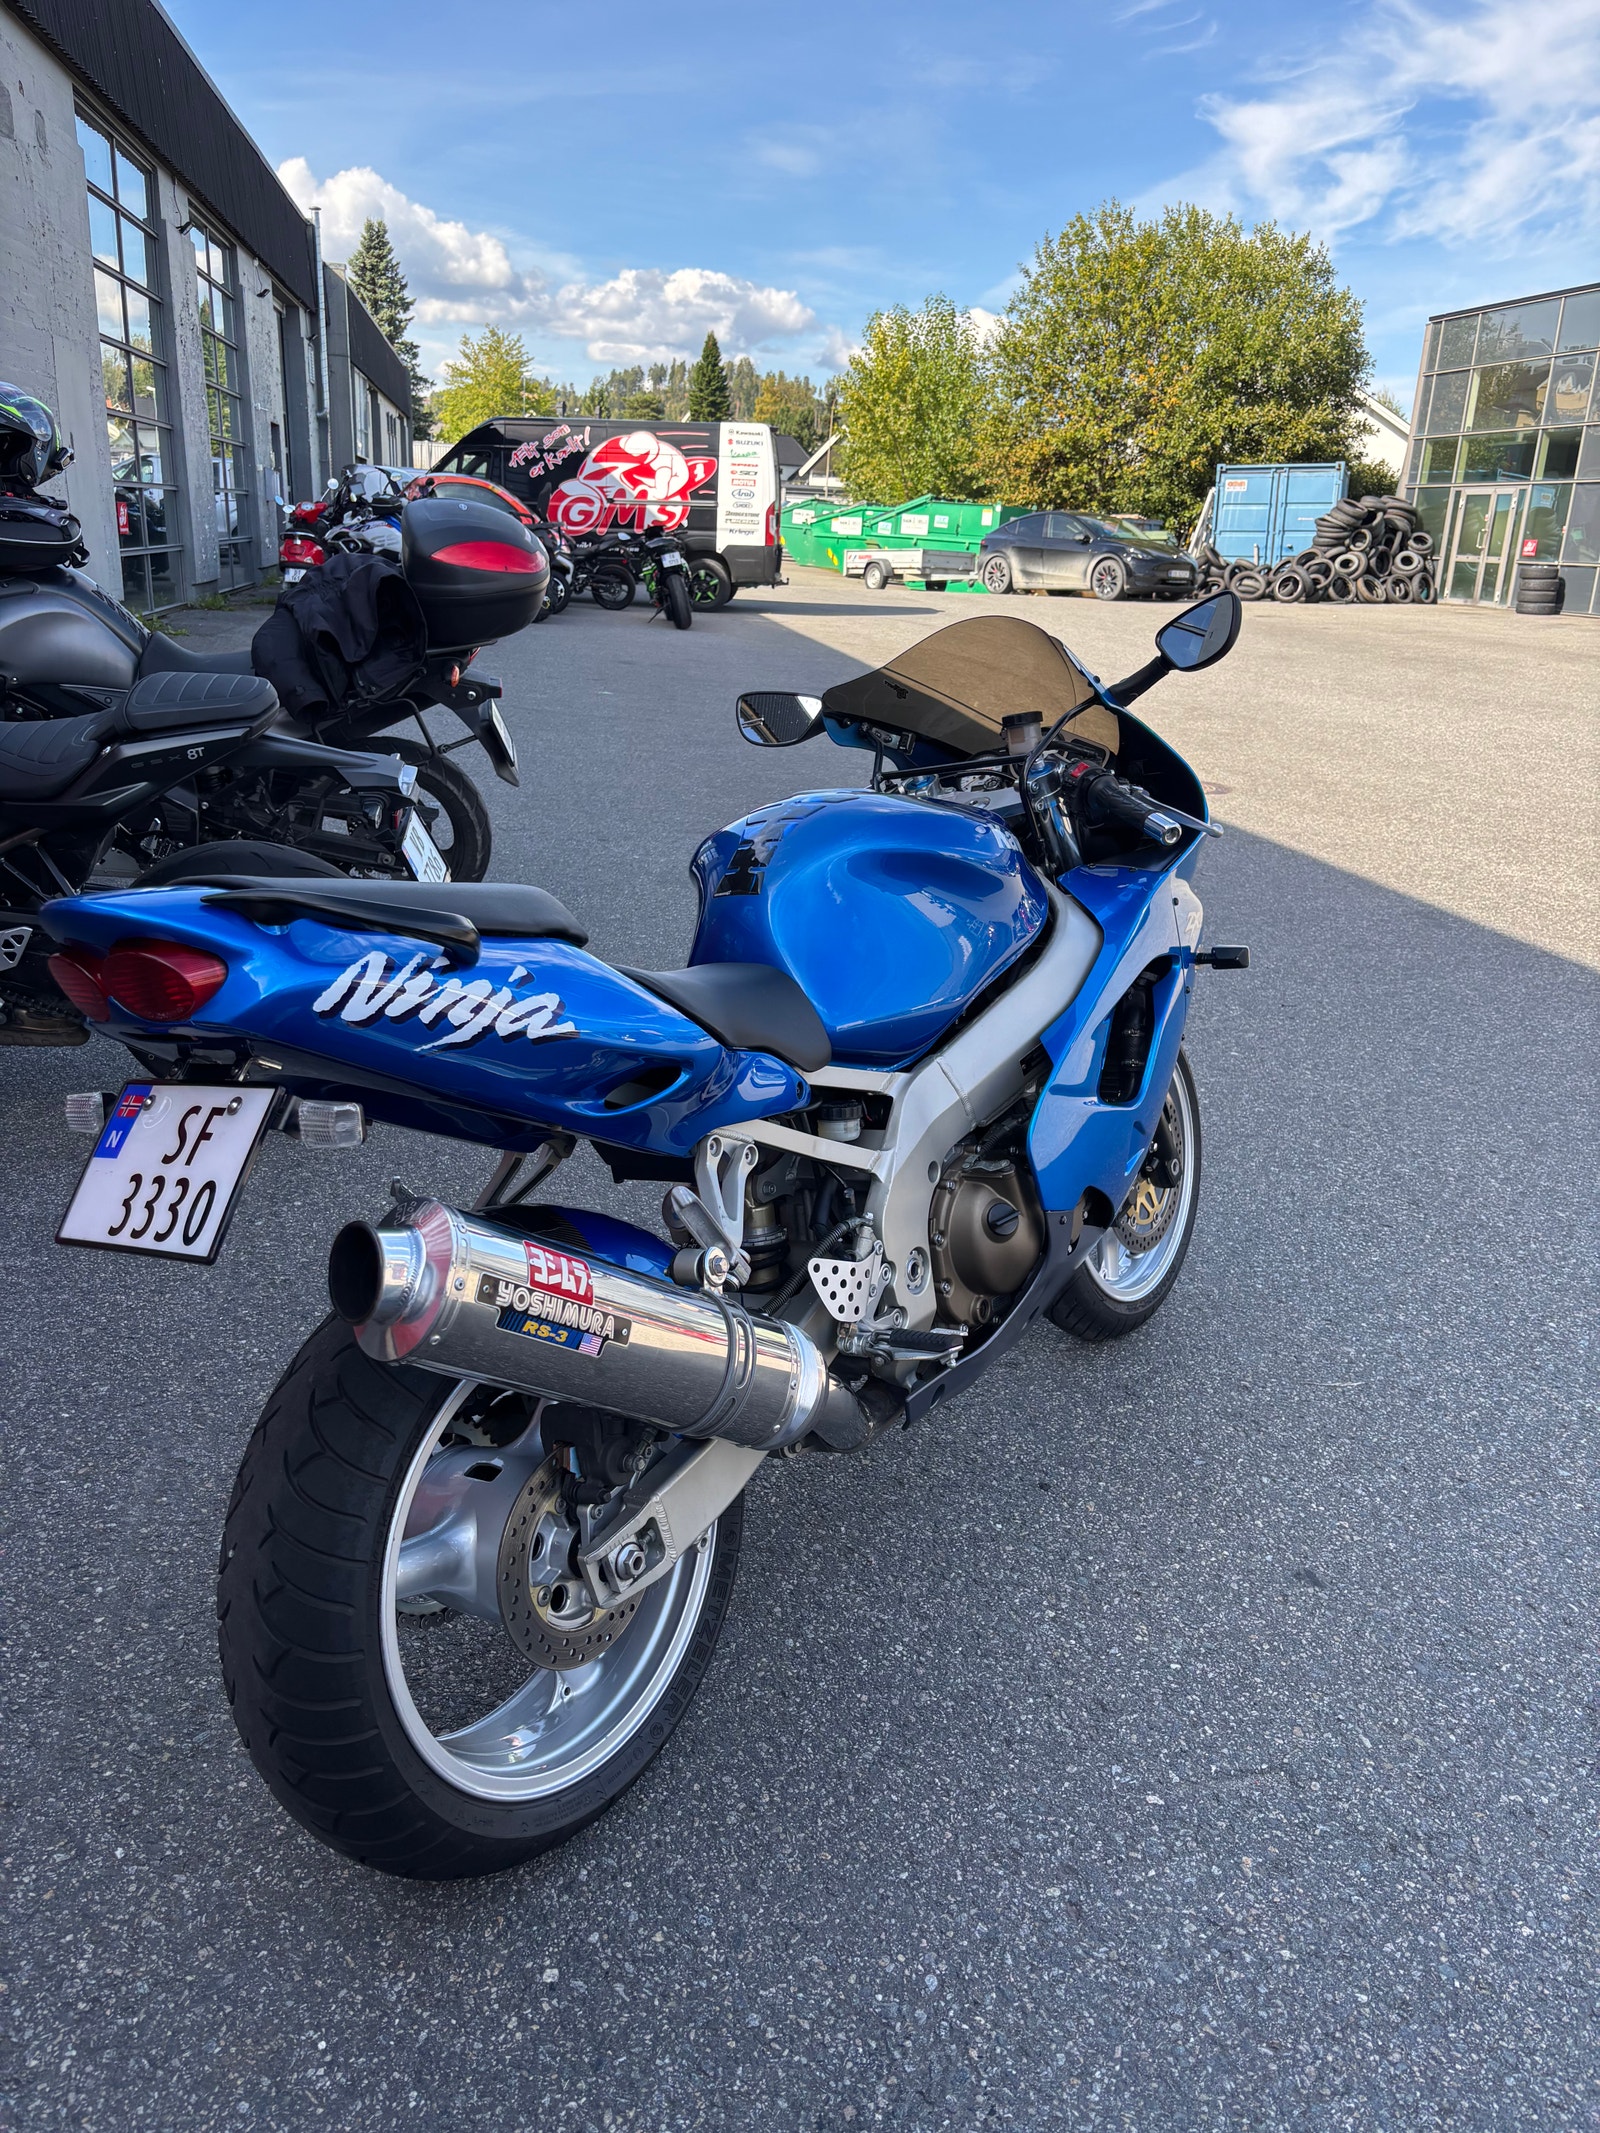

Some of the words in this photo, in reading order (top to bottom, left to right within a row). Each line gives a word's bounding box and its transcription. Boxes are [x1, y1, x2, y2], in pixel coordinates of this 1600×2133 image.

[542, 423, 571, 450] som
[529, 461, 545, 478] er
[561, 488, 677, 535] GMS
[736, 489, 751, 497] Arai
[186, 746, 205, 760] 8T
[312, 951, 577, 1052] Ninja
[105, 1130, 124, 1148] N
[161, 1105, 227, 1166] SF
[107, 1173, 217, 1247] 3330
[495, 1281, 615, 1340] YOSHIMURA
[522, 1320, 569, 1343] RS-3
[663, 1552, 734, 1722] METZELER
